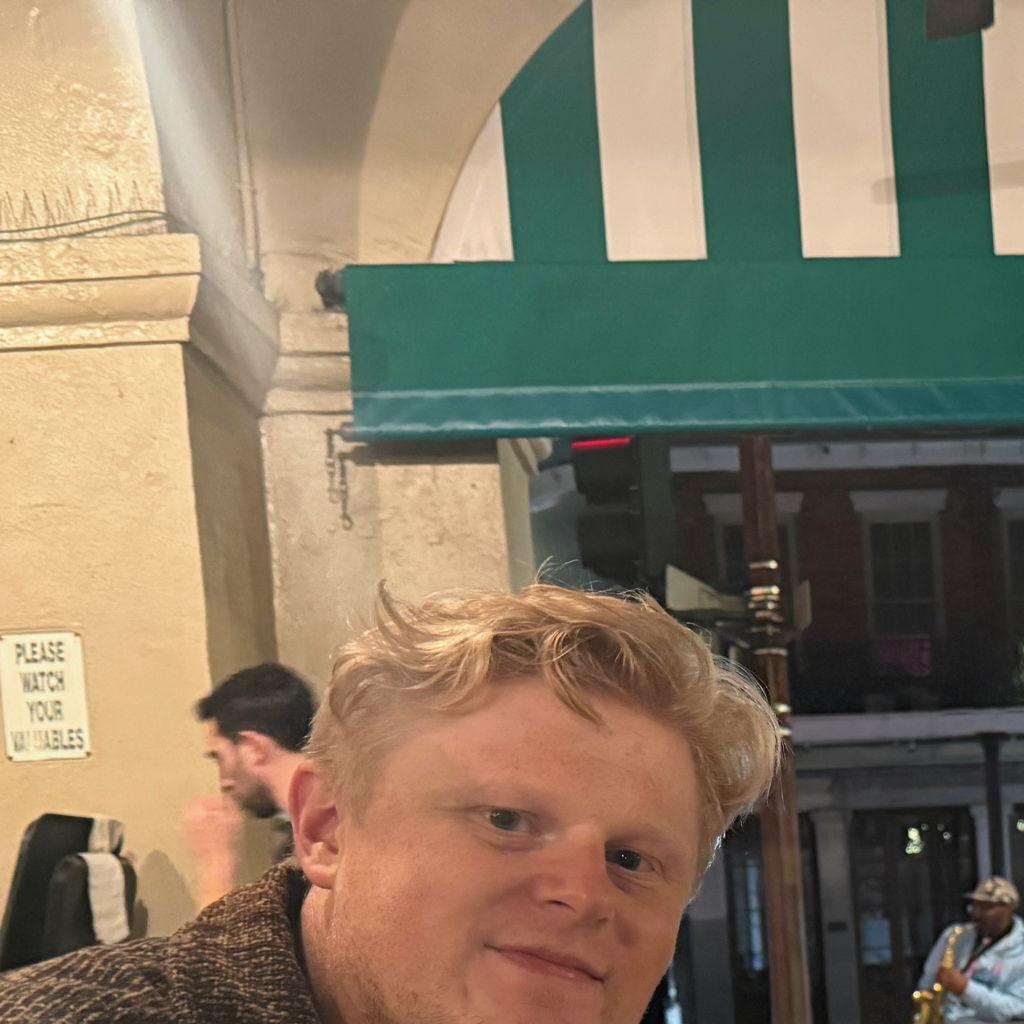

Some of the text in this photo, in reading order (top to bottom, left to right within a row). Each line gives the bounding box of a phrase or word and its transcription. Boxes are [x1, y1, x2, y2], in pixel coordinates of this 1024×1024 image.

[15, 641, 65, 664] PLEASE
[21, 671, 65, 692] WATCH
[26, 700, 63, 721] YOUR
